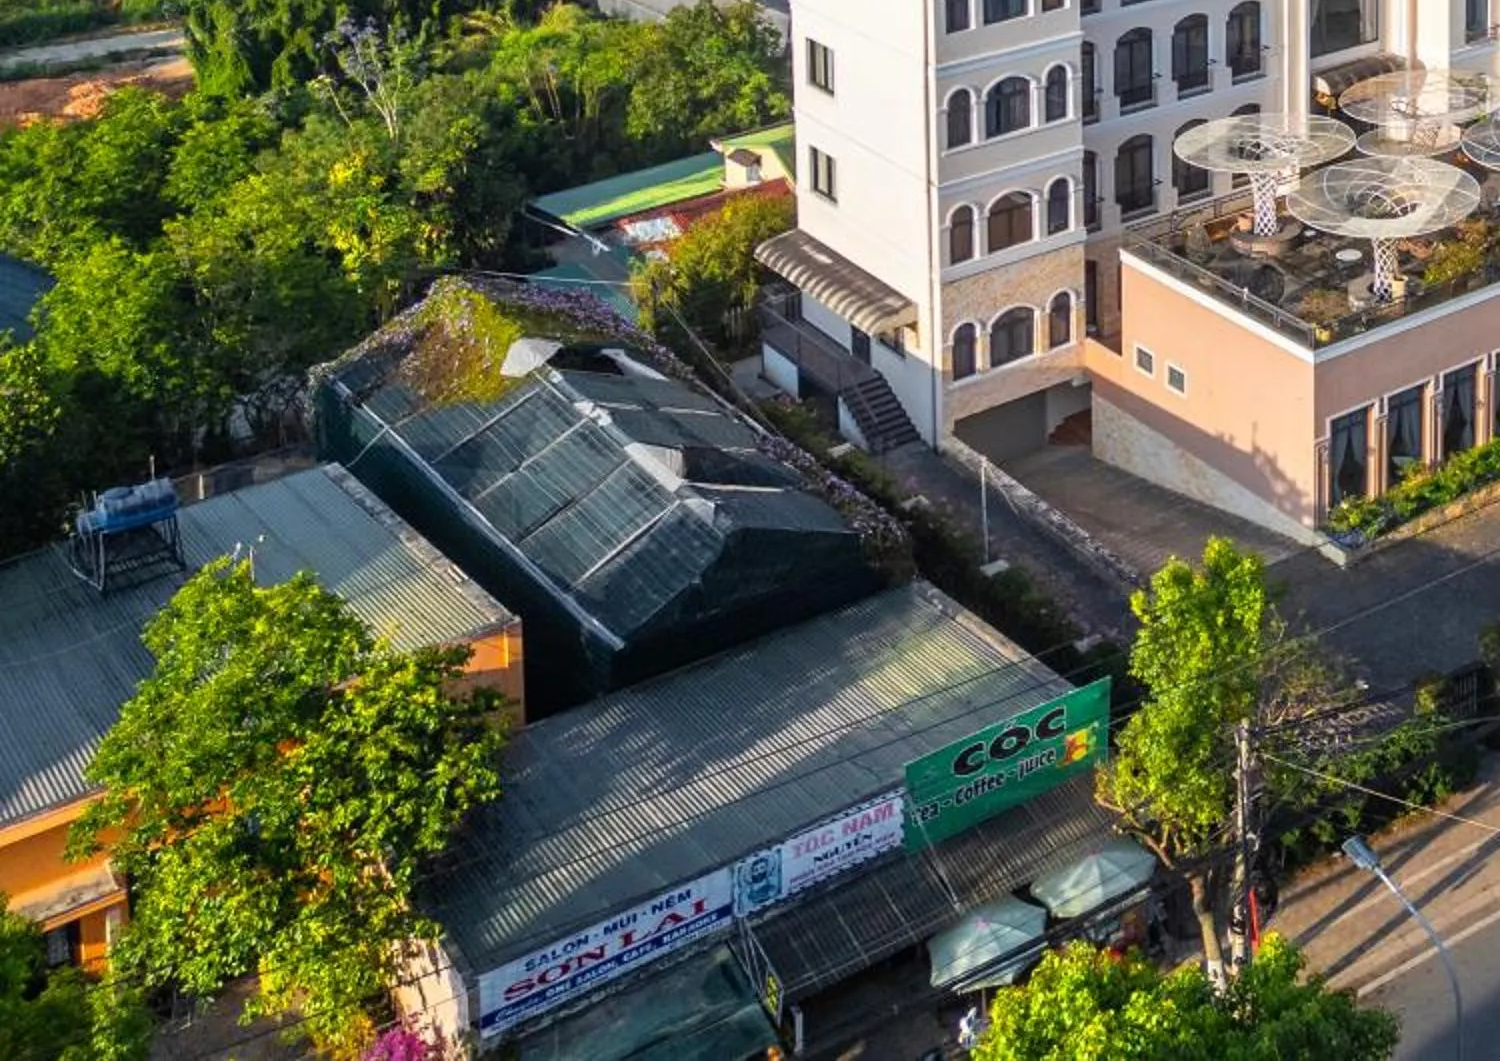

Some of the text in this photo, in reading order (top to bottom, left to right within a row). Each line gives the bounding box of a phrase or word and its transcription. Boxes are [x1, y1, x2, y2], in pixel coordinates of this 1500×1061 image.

[954, 770, 1007, 806] Coffee
[841, 801, 895, 836] NAM
[525, 934, 589, 972] SALON
